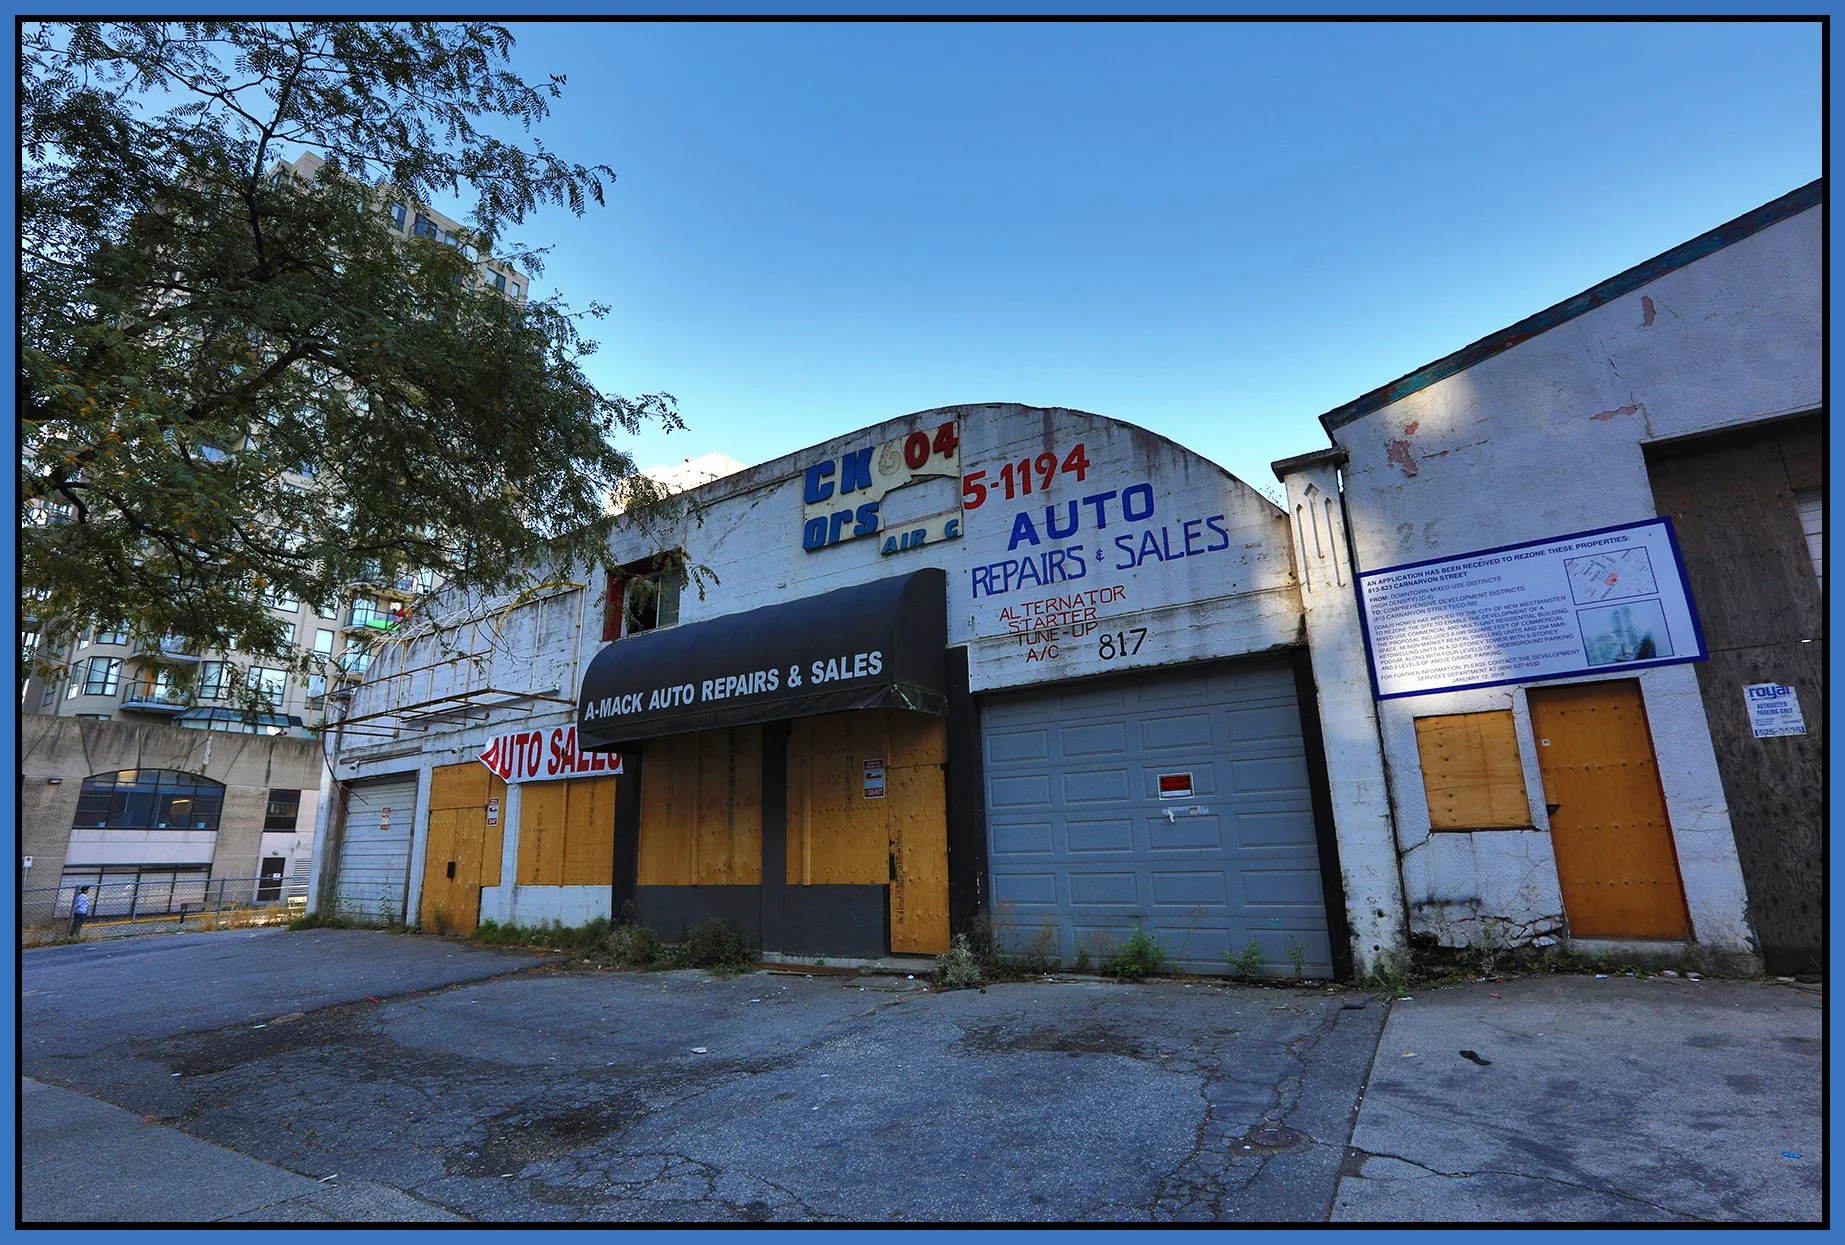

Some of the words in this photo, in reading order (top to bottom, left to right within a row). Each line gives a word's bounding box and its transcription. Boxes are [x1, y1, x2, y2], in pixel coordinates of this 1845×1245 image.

[879, 422, 958, 476] 604
[804, 447, 875, 504] CK
[963, 443, 1091, 510] 5-1194
[803, 501, 880, 552] ors
[1007, 483, 1155, 551] AUTO
[881, 528, 927, 555] AIR
[944, 519, 959, 539] C
[972, 544, 1086, 598] REPAIRS
[1094, 548, 1104, 563] &
[1115, 515, 1229, 570] SALES
[1378, 572, 1424, 585] APPLICATION
[1441, 565, 1461, 573] BEEN
[1463, 558, 1500, 570] RECEIVED
[1514, 550, 1546, 561] REZONE
[1547, 545, 1573, 555] THESE
[1575, 535, 1631, 550] PROPERTIES:
[1390, 588, 1429, 600] DOWNTOWN
[1430, 585, 1450, 593] MIXED
[1466, 576, 1502, 587] DISTRICTS
[1393, 576, 1438, 589] CARNARVON
[1440, 571, 1468, 581] STREET
[999, 585, 1126, 621] ALTERNATOR
[1370, 602, 1388, 610] (HIGH
[1383, 600, 1438, 614] COMPREHENSIVE
[1438, 592, 1488, 605] DEVELOPMENT
[1489, 586, 1526, 597] DISTRICTS
[1430, 613, 1454, 621] APPLIED
[1519, 596, 1567, 608] WESTMINSTER
[1009, 607, 1097, 632] STARTER
[1384, 627, 1407, 635] REZONE
[1444, 618, 1467, 626] ENABLE
[1482, 608, 1528, 620] DEVELOPMENT
[1386, 609, 1426, 621] CARNARVON
[1407, 627, 1446, 637] COMMERCIAL
[1496, 613, 1537, 624] RESIDENTIAL
[1015, 621, 1098, 647] TUNE-UP
[1099, 627, 1148, 661] 817
[1389, 637, 1420, 646] PROPOSAL
[1421, 633, 1450, 641] INCLUDES
[1467, 626, 1493, 634] SQUARE
[1521, 616, 1565, 626] COMMERCIAL
[1446, 636, 1469, 644] RENTAL
[1471, 631, 1503, 640] DWELLING
[1485, 636, 1508, 644] TOWER
[1026, 646, 1060, 663] A/C
[1405, 654, 1425, 662] ALONG
[1460, 646, 1483, 654] LEVELS
[1494, 638, 1543, 649] UNDERGROUND
[1487, 658, 1517, 666] CONTACT
[1532, 649, 1580, 660] DEVELOPMENT
[584, 692, 643, 721] A-MACK
[648, 684, 695, 711] AUTO
[701, 668, 779, 702] REPAIRS
[787, 665, 803, 688] &
[811, 650, 883, 685] SALES
[1418, 673, 1446, 681] SERVICES
[1447, 668, 1487, 677] DEPARTMENT
[1452, 675, 1480, 683] JANUARY
[1748, 686, 1790, 699] royal
[480, 730, 543, 780] AUTO
